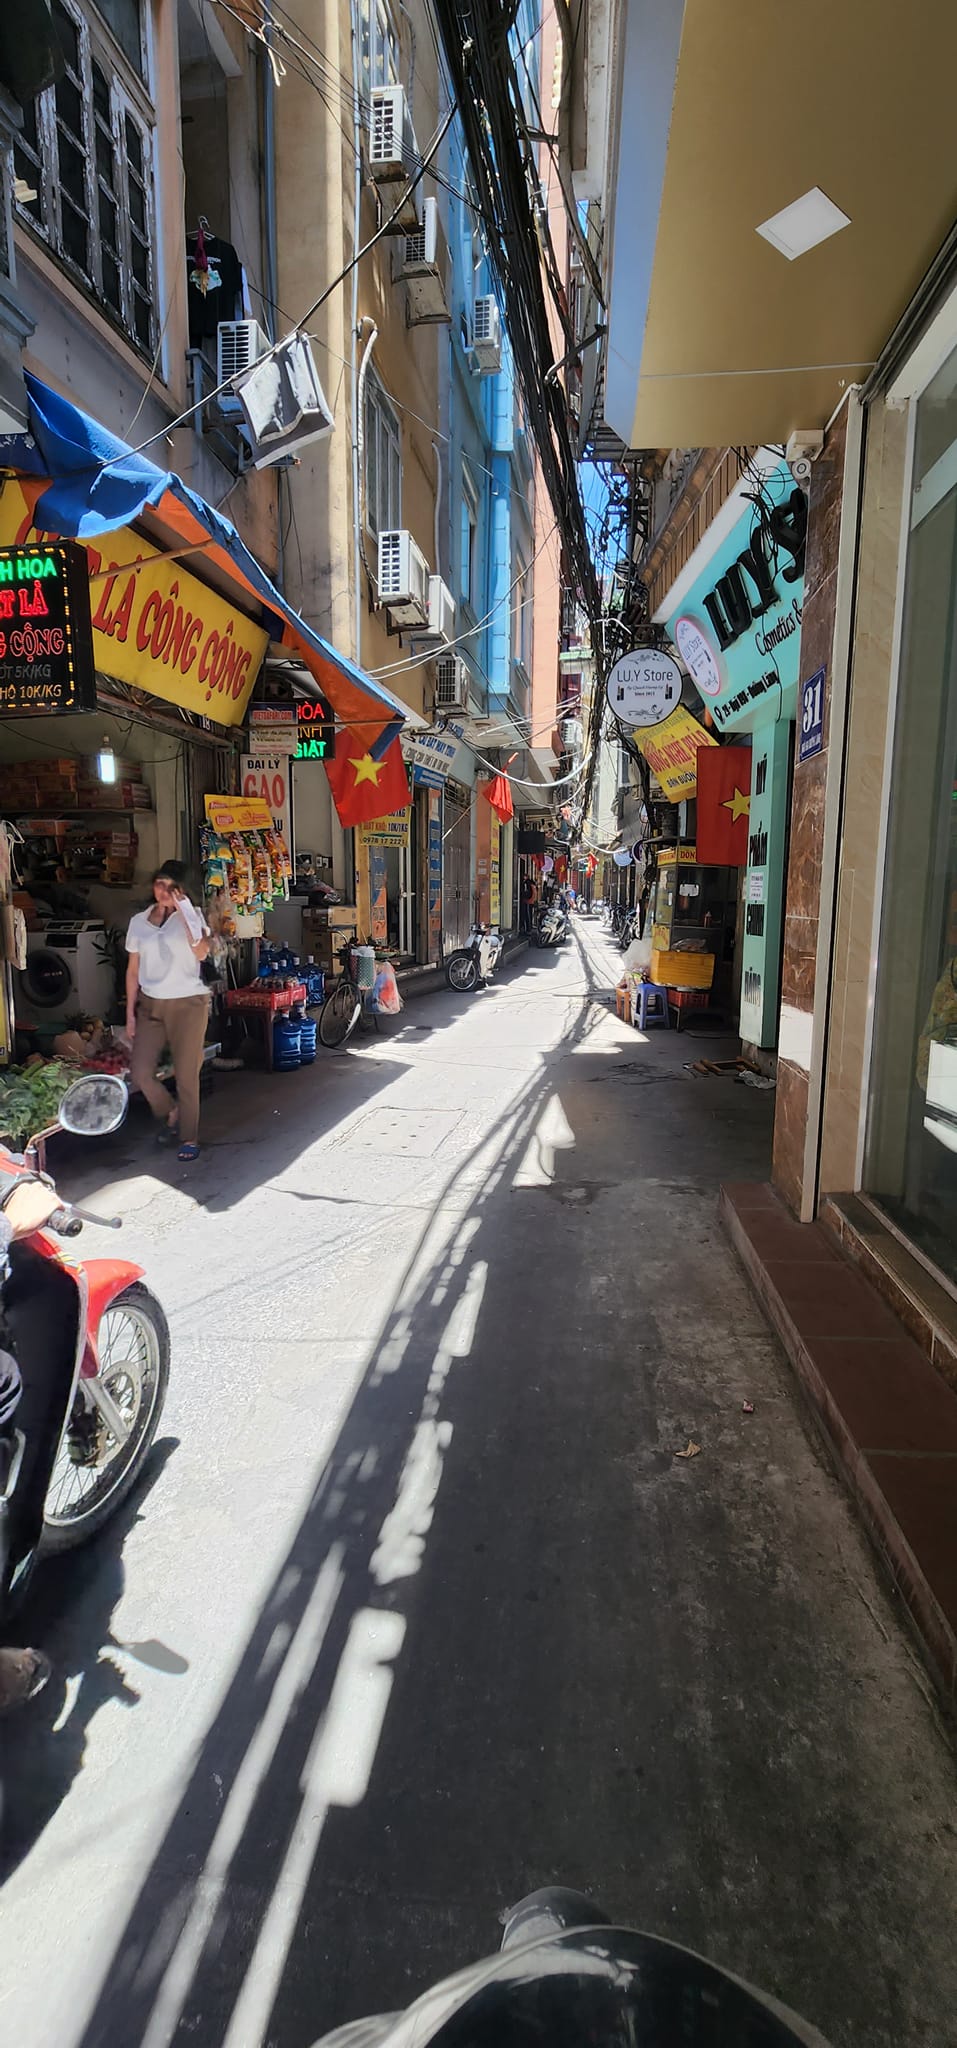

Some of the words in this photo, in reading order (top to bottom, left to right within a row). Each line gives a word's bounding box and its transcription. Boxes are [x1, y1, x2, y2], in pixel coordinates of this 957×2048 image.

[17, 557, 57, 580] HOA
[9, 622, 65, 662] CỘNG
[136, 580, 203, 675] CÔNG
[199, 619, 252, 701] CỘNG
[643, 669, 674, 682] Store
[19, 684, 62, 700] 10K/KG
[803, 680, 821, 734] 31
[247, 760, 265, 771] ĐẠI
